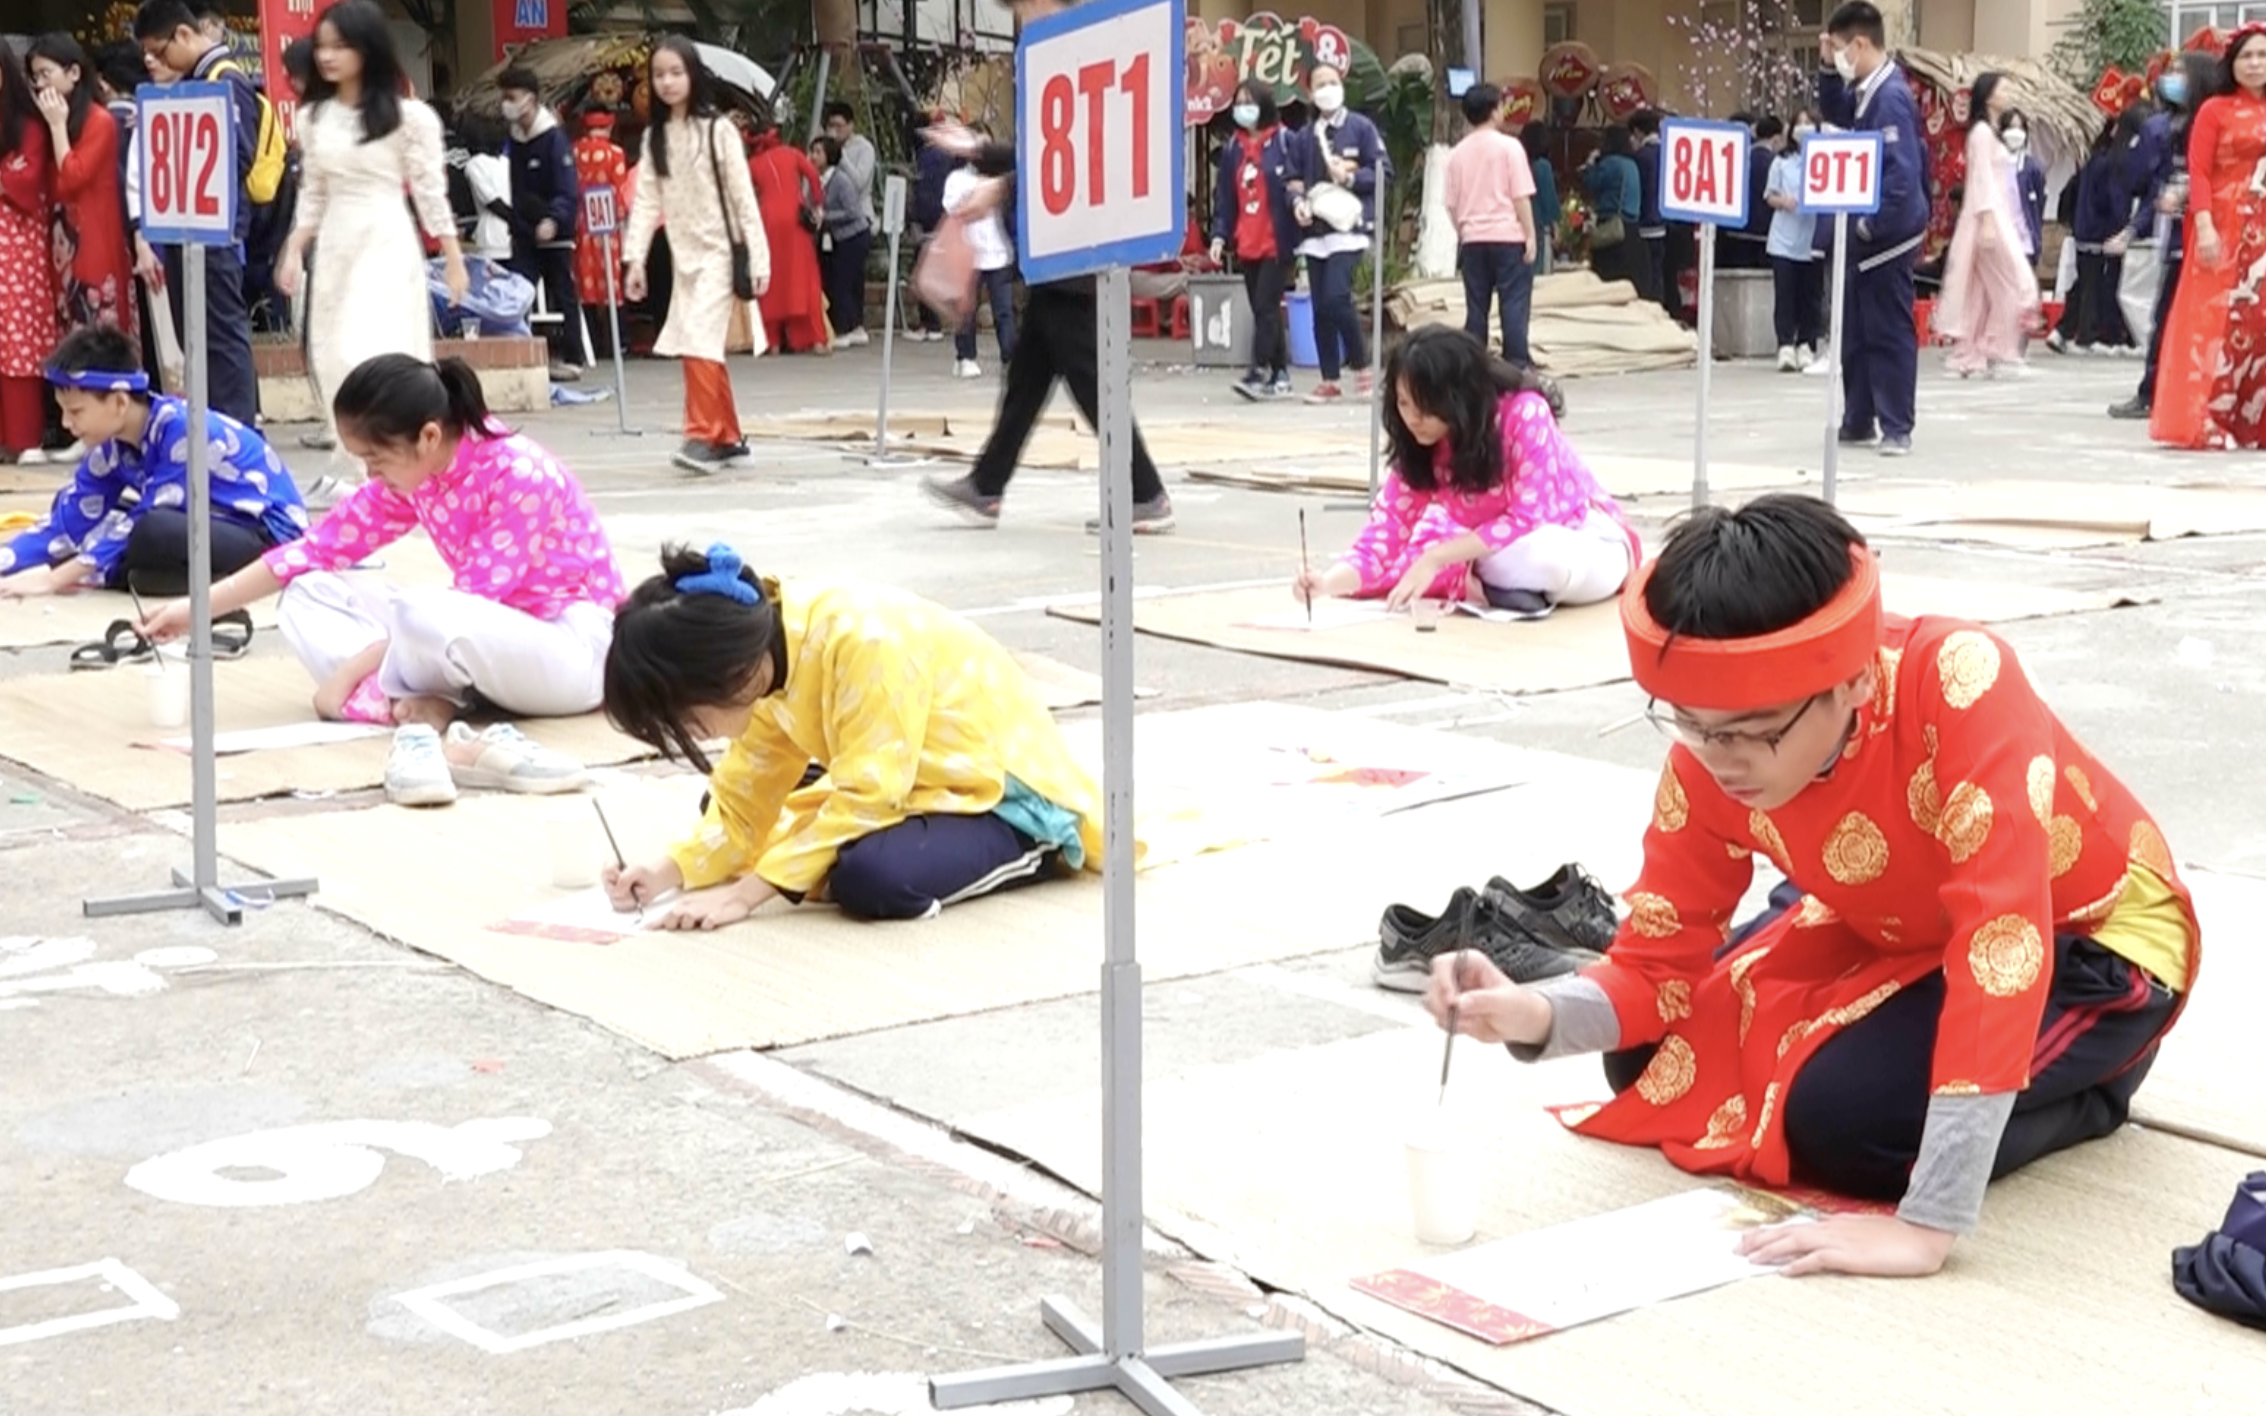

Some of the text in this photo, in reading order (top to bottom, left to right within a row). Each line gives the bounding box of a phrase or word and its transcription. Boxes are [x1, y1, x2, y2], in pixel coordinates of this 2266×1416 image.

[1239, 22, 1301, 86] Tết
[150, 112, 219, 215] 8V2
[1041, 52, 1149, 216] 8T1
[1673, 136, 1735, 206] 8A1
[1809, 151, 1869, 194] 9T1
[590, 195, 612, 228] 9A1
